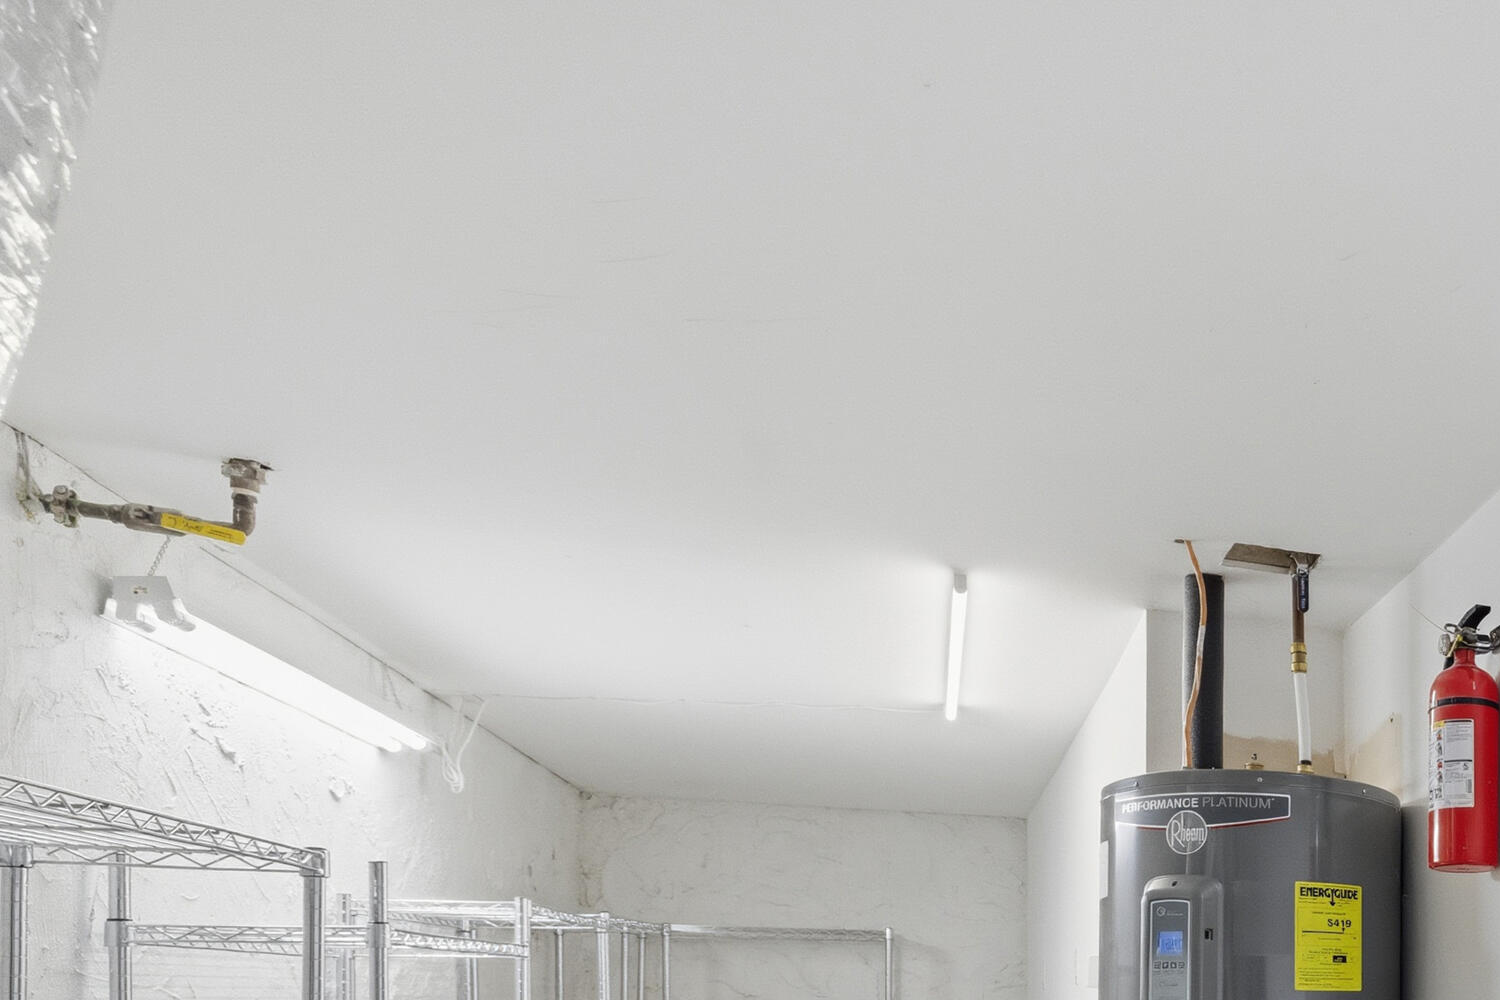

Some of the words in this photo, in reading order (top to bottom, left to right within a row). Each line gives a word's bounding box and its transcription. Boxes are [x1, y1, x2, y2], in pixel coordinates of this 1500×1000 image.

[1121, 797, 1199, 814] PERFORMANCE
[1202, 796, 1271, 809] PLATINUM
[1171, 813, 1205, 848] Rheem
[1299, 886, 1359, 901] ENERGYGUIDE
